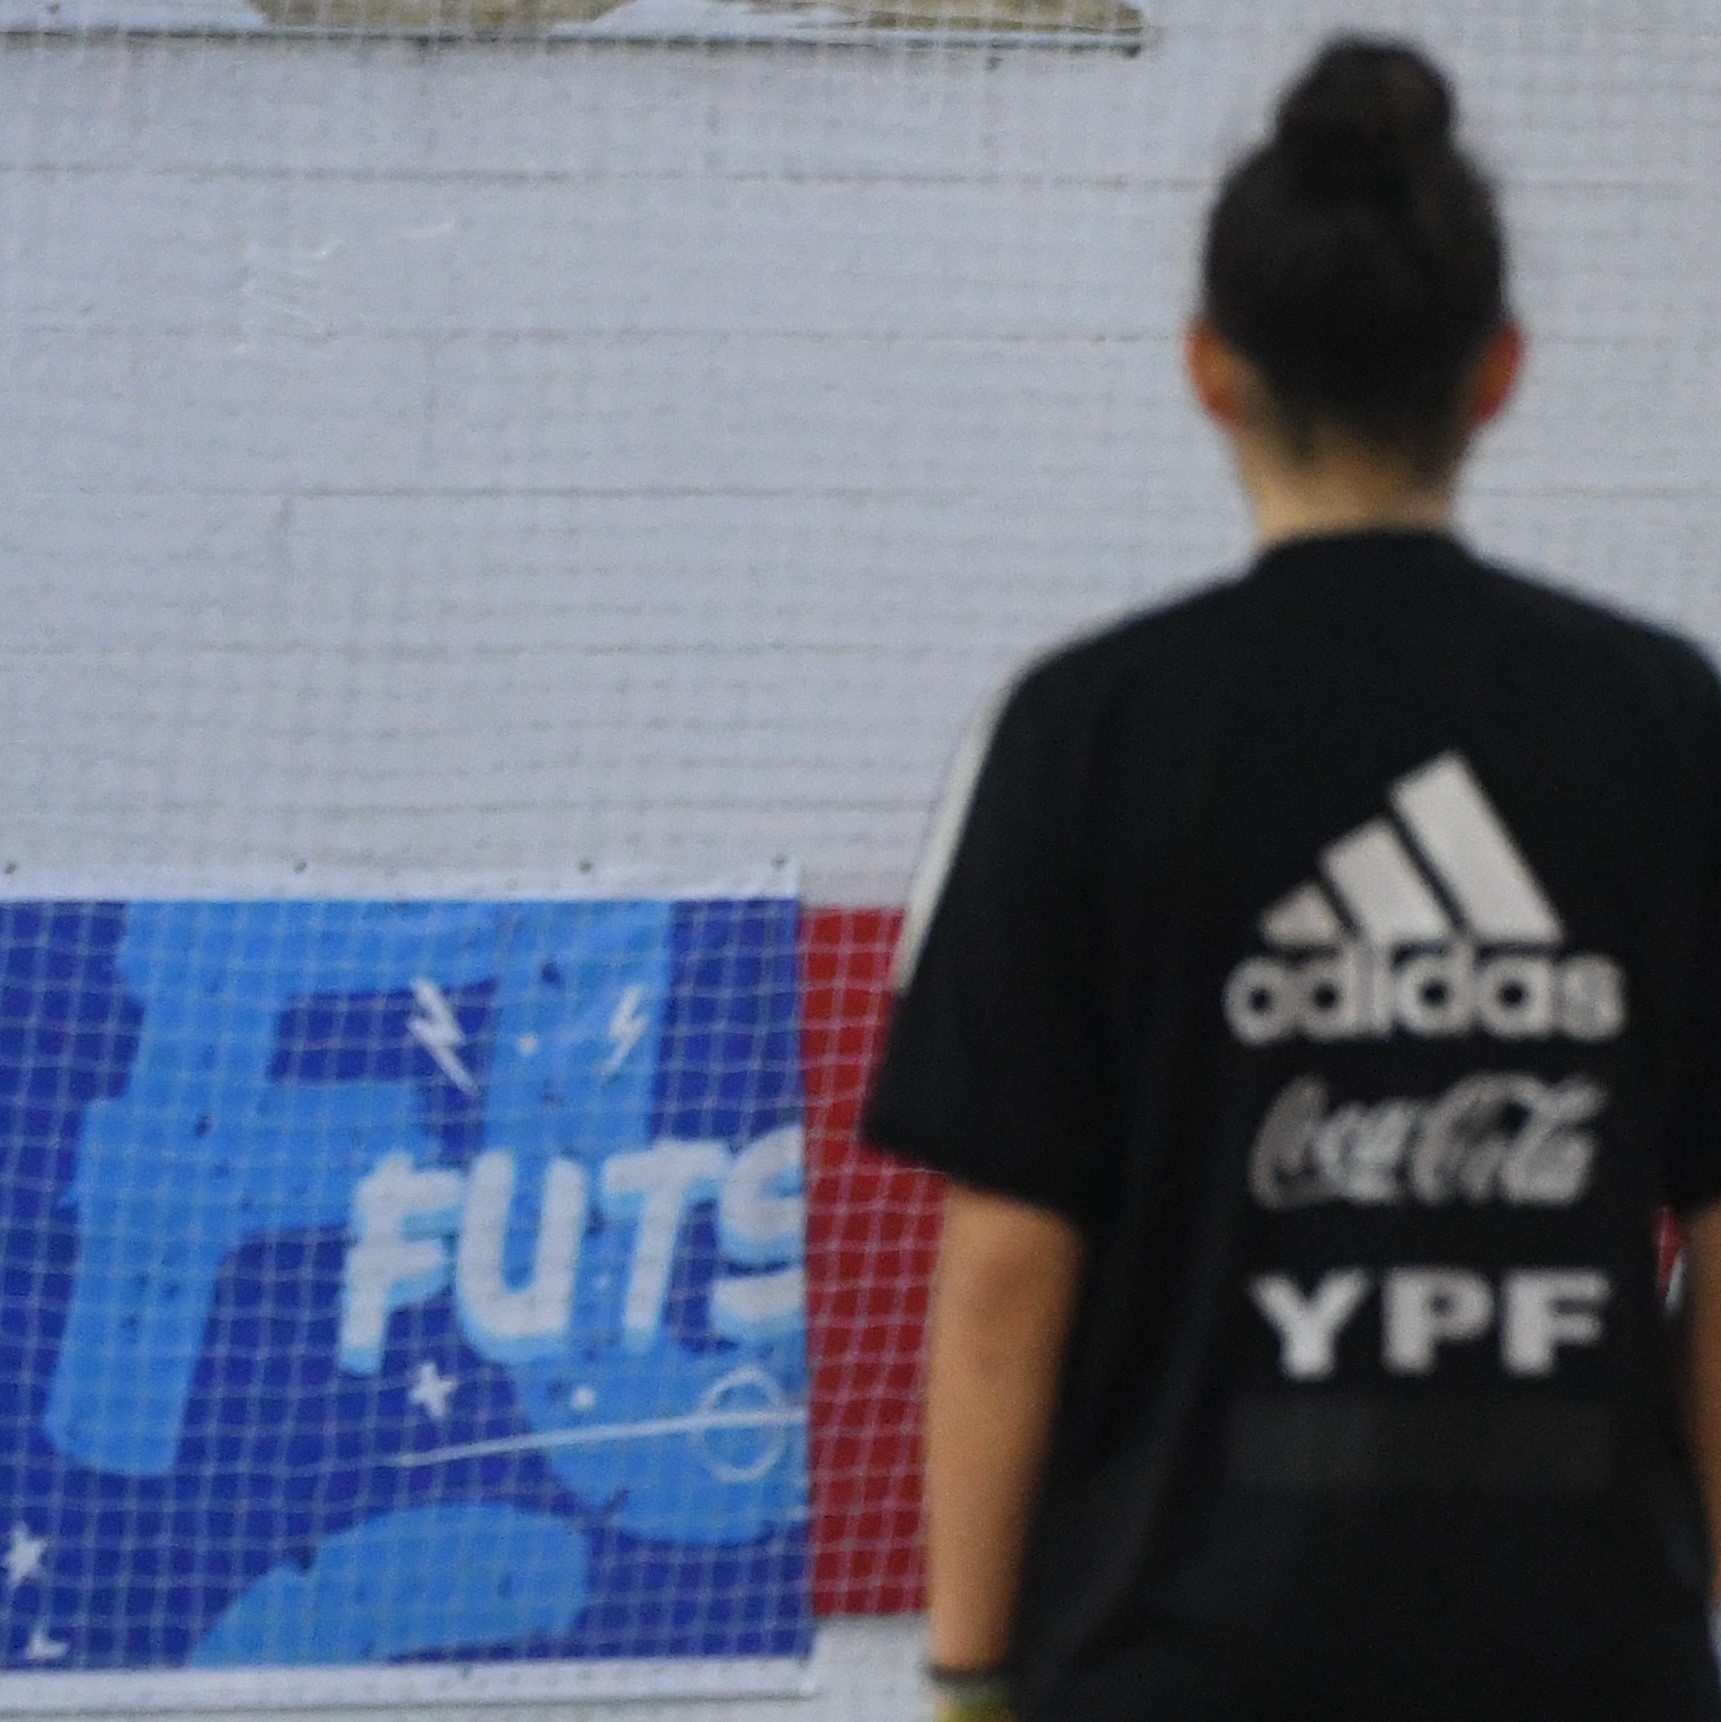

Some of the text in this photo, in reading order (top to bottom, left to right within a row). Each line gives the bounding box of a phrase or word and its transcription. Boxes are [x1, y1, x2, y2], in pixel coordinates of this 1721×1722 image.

[1222, 942, 1628, 1047] adidas
[339, 1126, 806, 1374] FUTS
[1248, 1265, 1612, 1381] YPF
